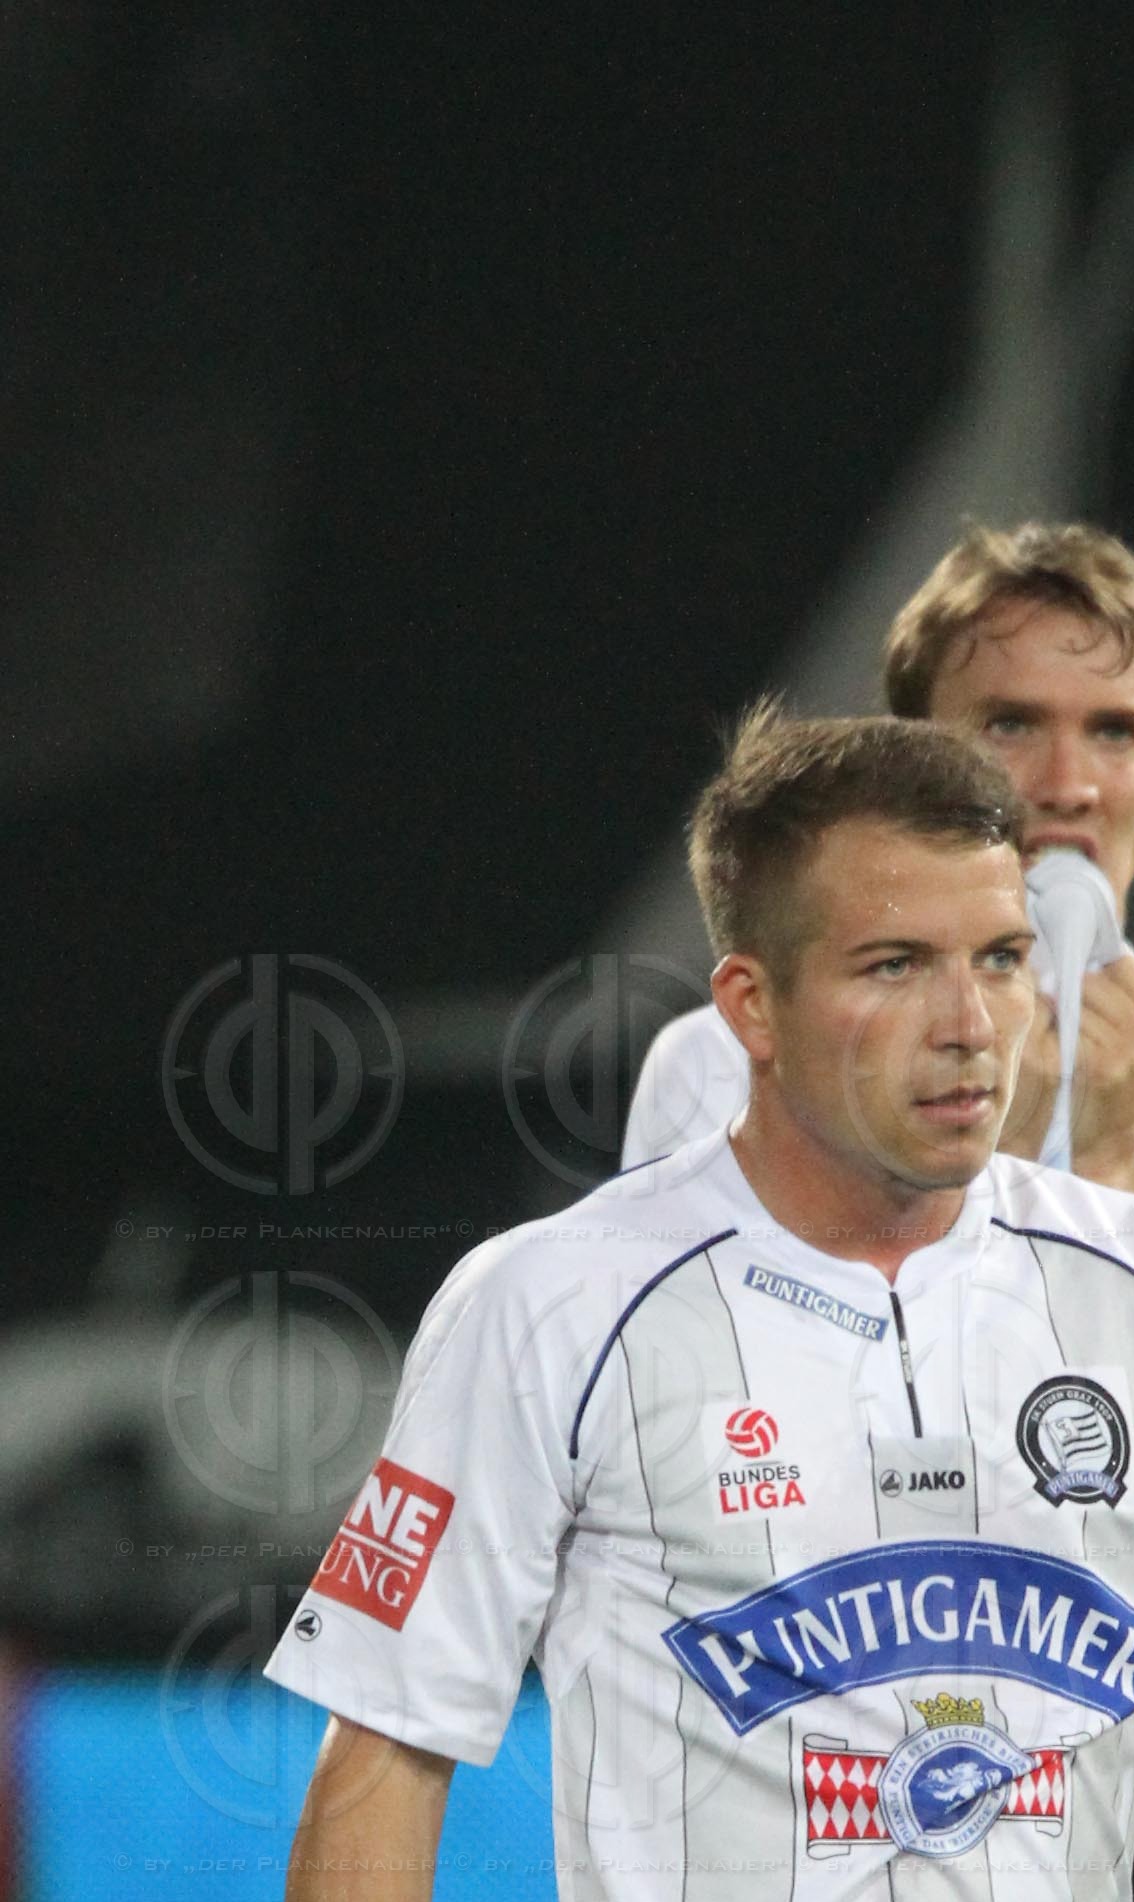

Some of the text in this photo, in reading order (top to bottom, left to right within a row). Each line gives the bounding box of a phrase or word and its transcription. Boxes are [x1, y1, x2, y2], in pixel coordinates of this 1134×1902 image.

[750, 1268, 882, 1339] PUNTIGAMER
[718, 1465, 800, 1486] BUNDES
[908, 1470, 965, 1491] JAKO
[719, 1480, 806, 1514] LIGA
